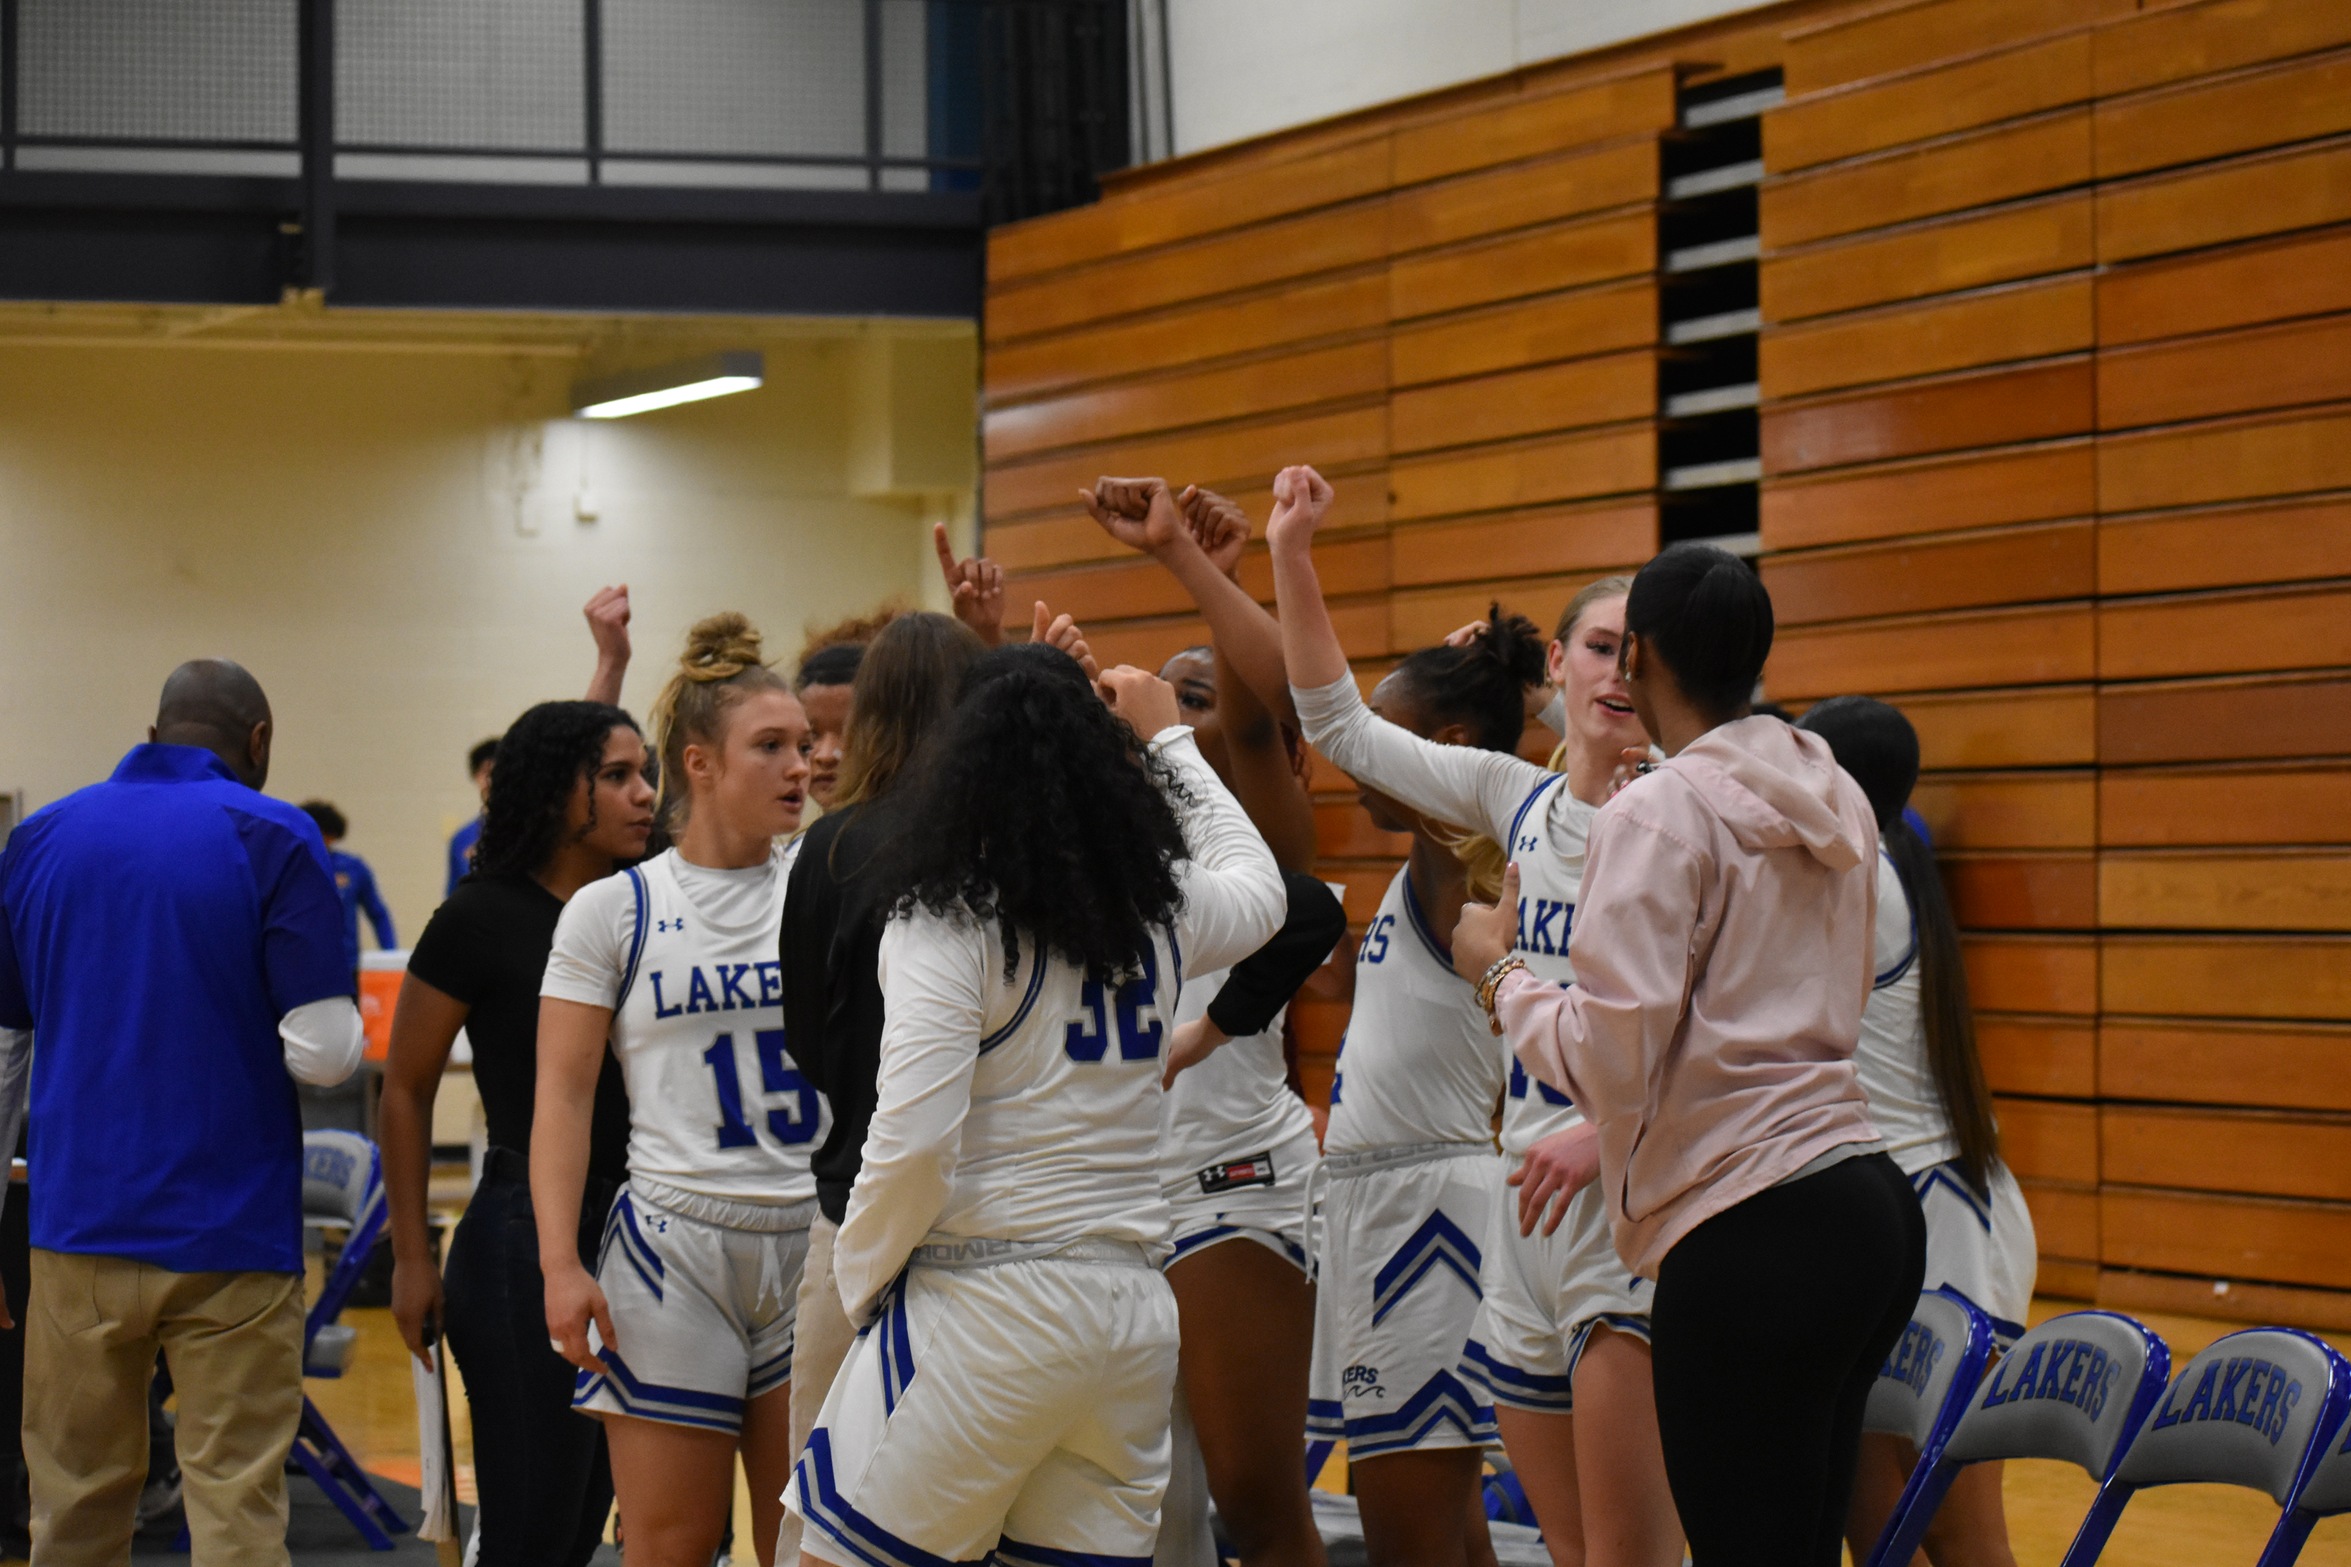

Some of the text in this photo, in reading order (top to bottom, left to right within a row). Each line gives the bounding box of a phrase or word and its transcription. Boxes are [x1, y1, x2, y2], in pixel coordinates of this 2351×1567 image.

[703, 1028, 820, 1149] 15
[1981, 1339, 2121, 1424] LAKERS
[2151, 1357, 2302, 1447] LAKERS
